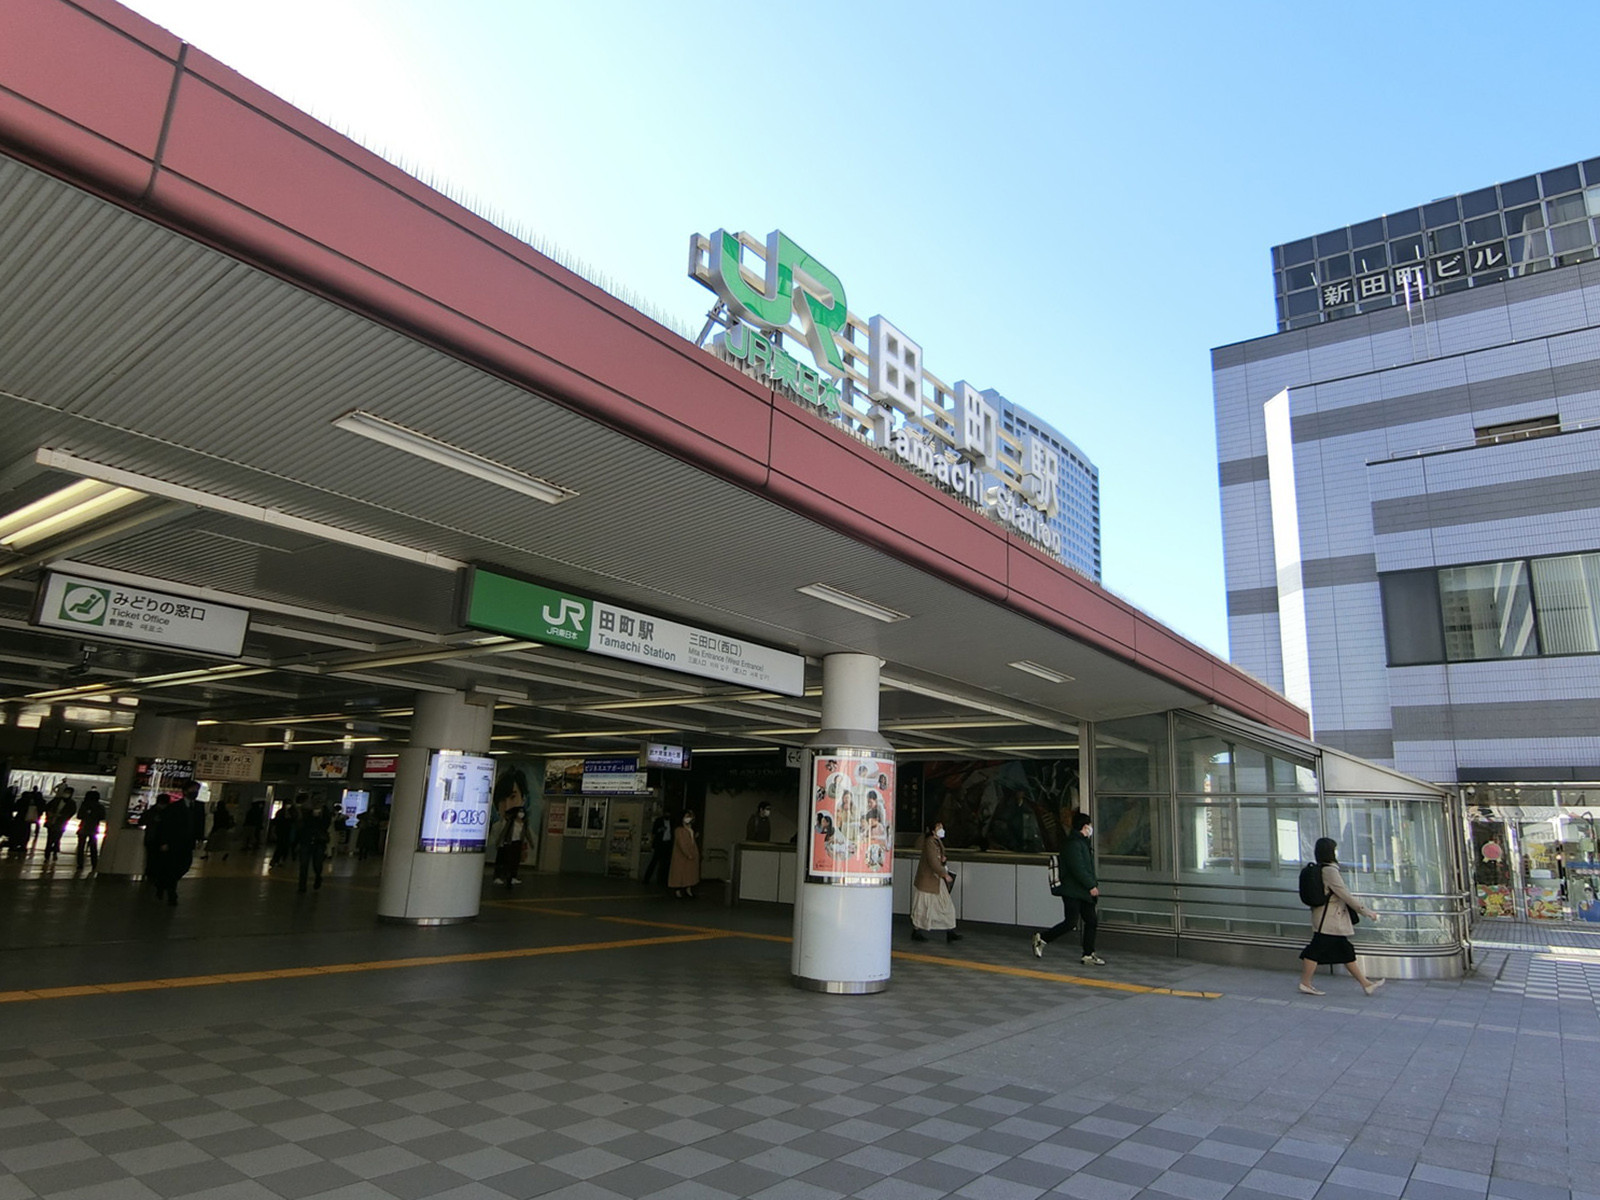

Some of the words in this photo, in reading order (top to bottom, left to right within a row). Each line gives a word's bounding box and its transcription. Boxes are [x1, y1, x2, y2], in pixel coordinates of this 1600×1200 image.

[1324, 247, 1503, 306] 新田町ビル
[710, 228, 847, 378] JR
[724, 325, 842, 417] JR東日本
[869, 315, 1060, 518] 田町駅
[873, 406, 984, 507] Tamachi
[987, 485, 1062, 553] Station
[111, 607, 141, 621] Ticket
[142, 613, 171, 626] Office
[113, 592, 206, 621] みどりの窓口
[542, 598, 586, 631] JR
[546, 627, 578, 641] JR東日本
[599, 609, 655, 642] 田町駅
[598, 633, 642, 655] Tamachi
[643, 643, 677, 662] Station
[701, 650, 725, 663] Entrance
[457, 809, 487, 826] RISO
